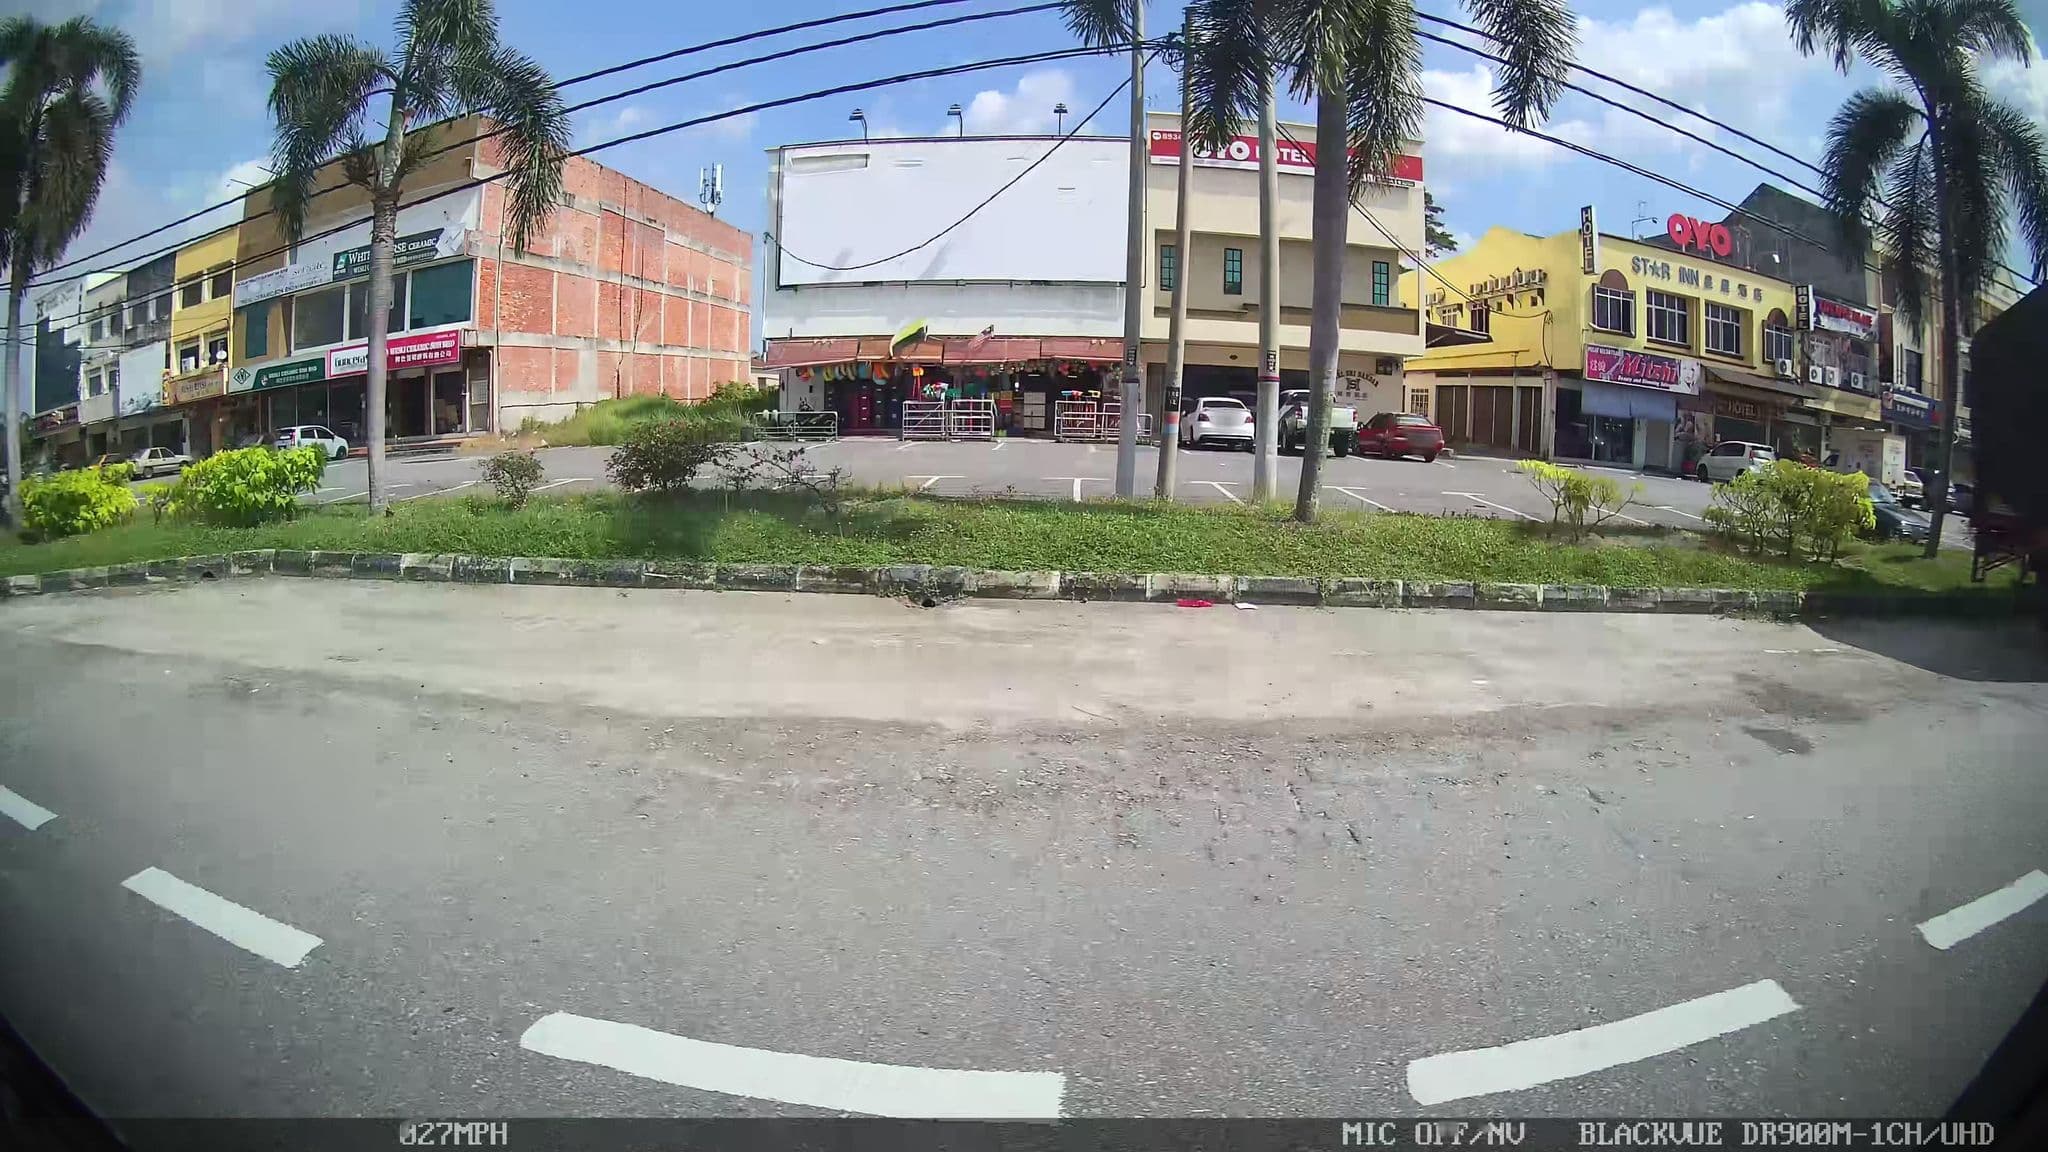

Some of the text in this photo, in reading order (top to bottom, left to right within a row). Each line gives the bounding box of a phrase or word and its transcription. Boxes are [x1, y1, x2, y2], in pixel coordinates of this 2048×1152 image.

[348, 250, 370, 265] WHIT
[408, 238, 437, 251] CERAMIC
[1582, 206, 1594, 273] HOTEL
[1667, 213, 1733, 257] OYO
[1679, 265, 1700, 287] INN
[1797, 287, 1809, 329] HOTEL
[1728, 400, 1756, 416] HOTEL
